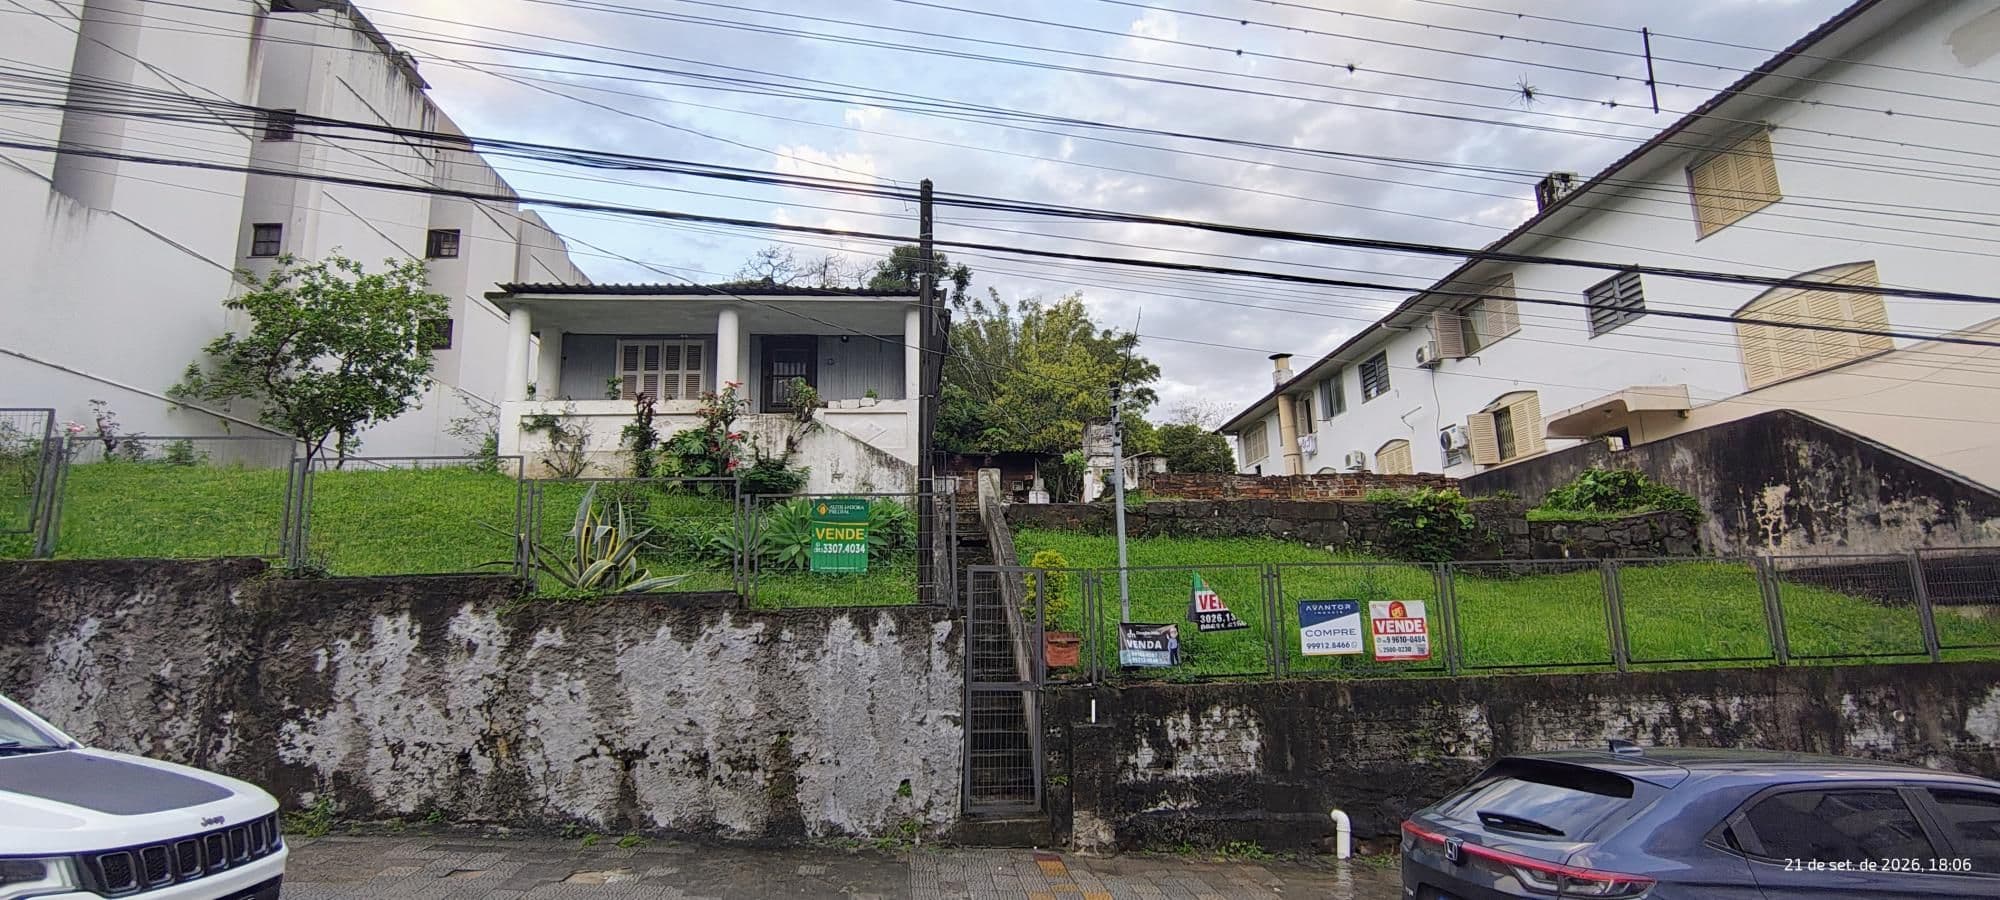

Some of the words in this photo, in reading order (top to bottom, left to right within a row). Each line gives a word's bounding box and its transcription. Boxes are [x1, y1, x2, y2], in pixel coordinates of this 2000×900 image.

[815, 527, 865, 540] VENDE
[823, 543, 866, 554] 3307.4034
[1375, 619, 1423, 634] VENDE
[1305, 628, 1357, 638] COMPRE
[1126, 639, 1162, 650] VENDA
[200, 815, 225, 828] Jeep
